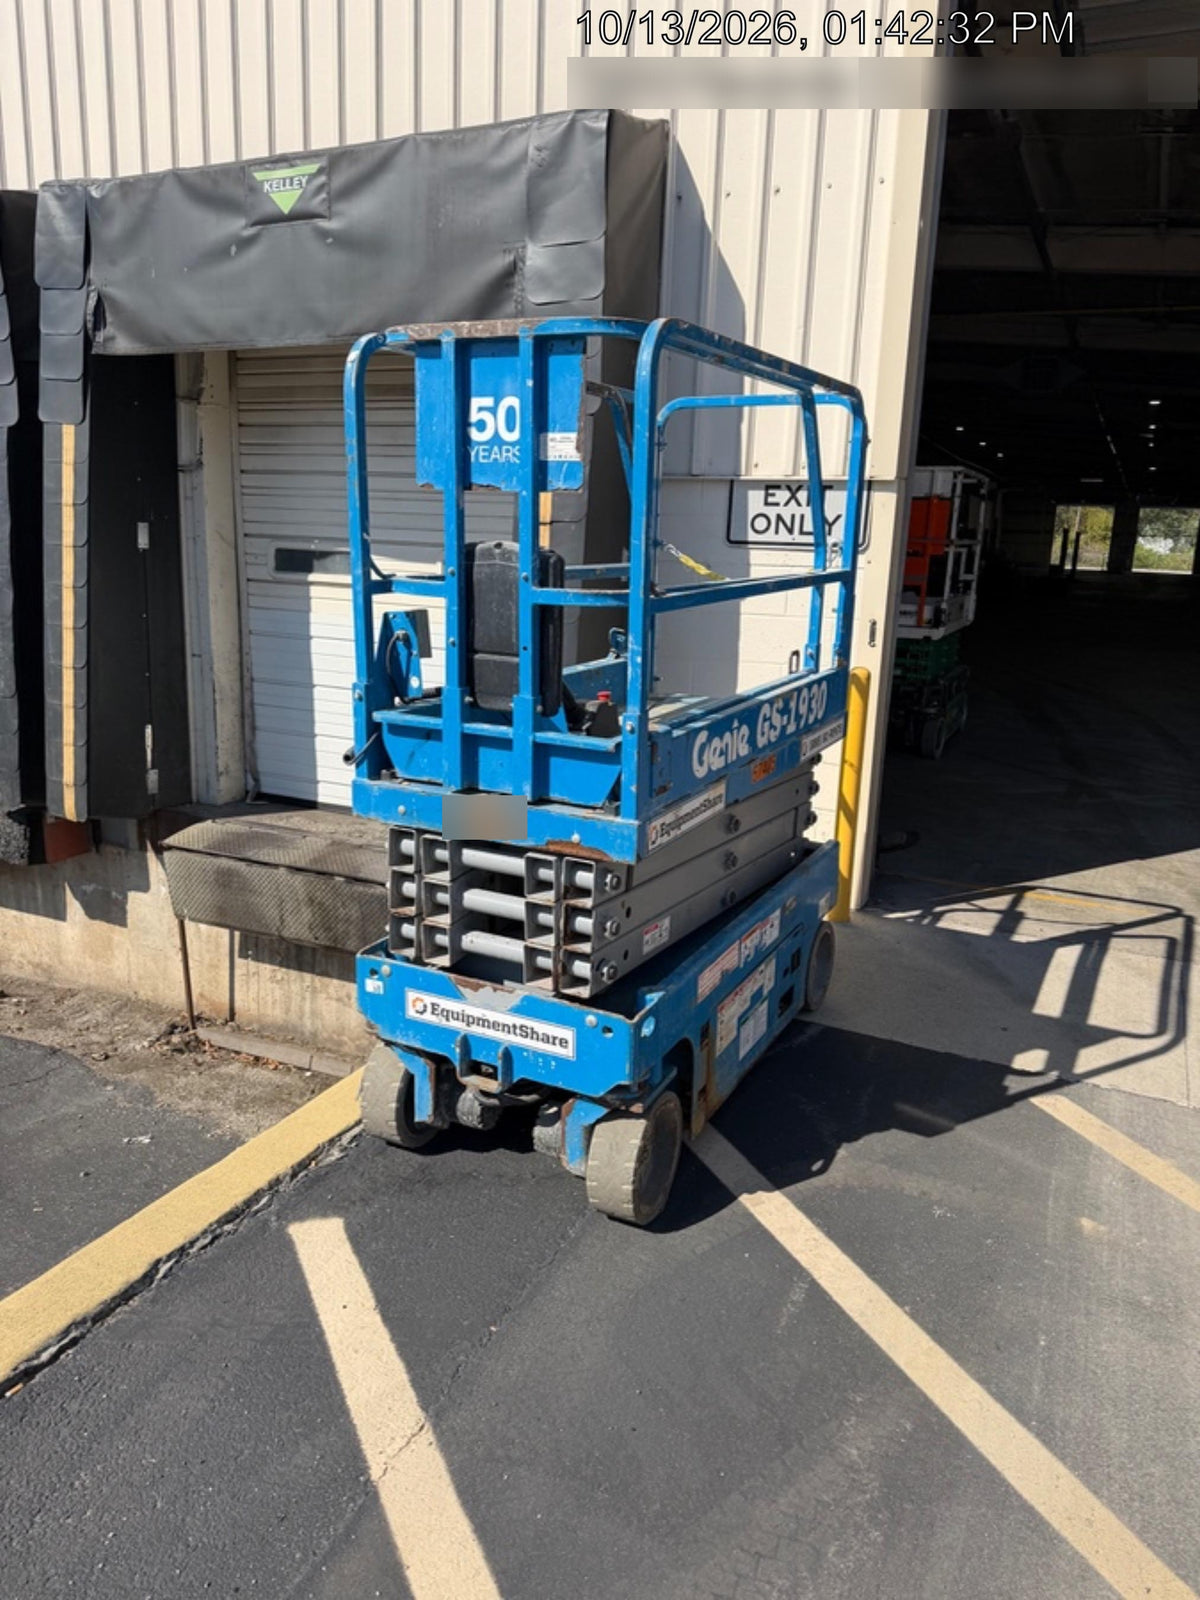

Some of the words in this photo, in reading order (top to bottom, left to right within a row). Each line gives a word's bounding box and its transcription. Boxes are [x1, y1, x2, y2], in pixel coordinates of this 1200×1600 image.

[264, 176, 308, 193] KELLEY
[467, 395, 521, 443] 50
[692, 718, 750, 779] Genie
[756, 680, 828, 749] GS-1930
[429, 1001, 570, 1050] EquipmentShare
